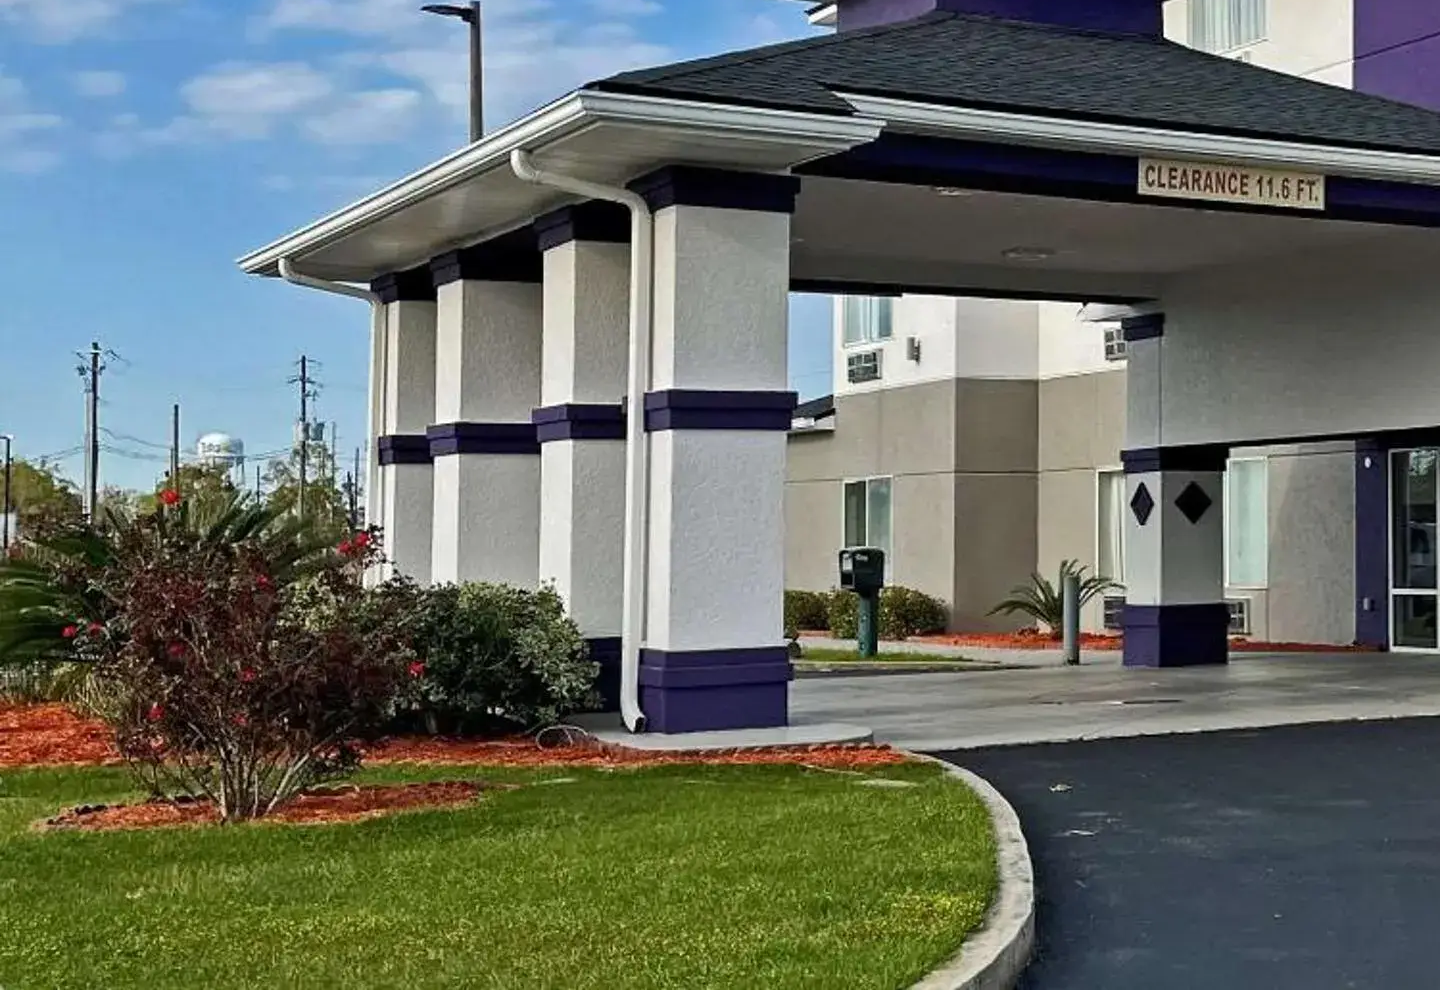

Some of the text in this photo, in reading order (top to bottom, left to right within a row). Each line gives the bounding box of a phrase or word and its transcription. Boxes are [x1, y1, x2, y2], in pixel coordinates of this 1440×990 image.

[1145, 165, 1319, 202] CLEARANCE 11.6 FT.
